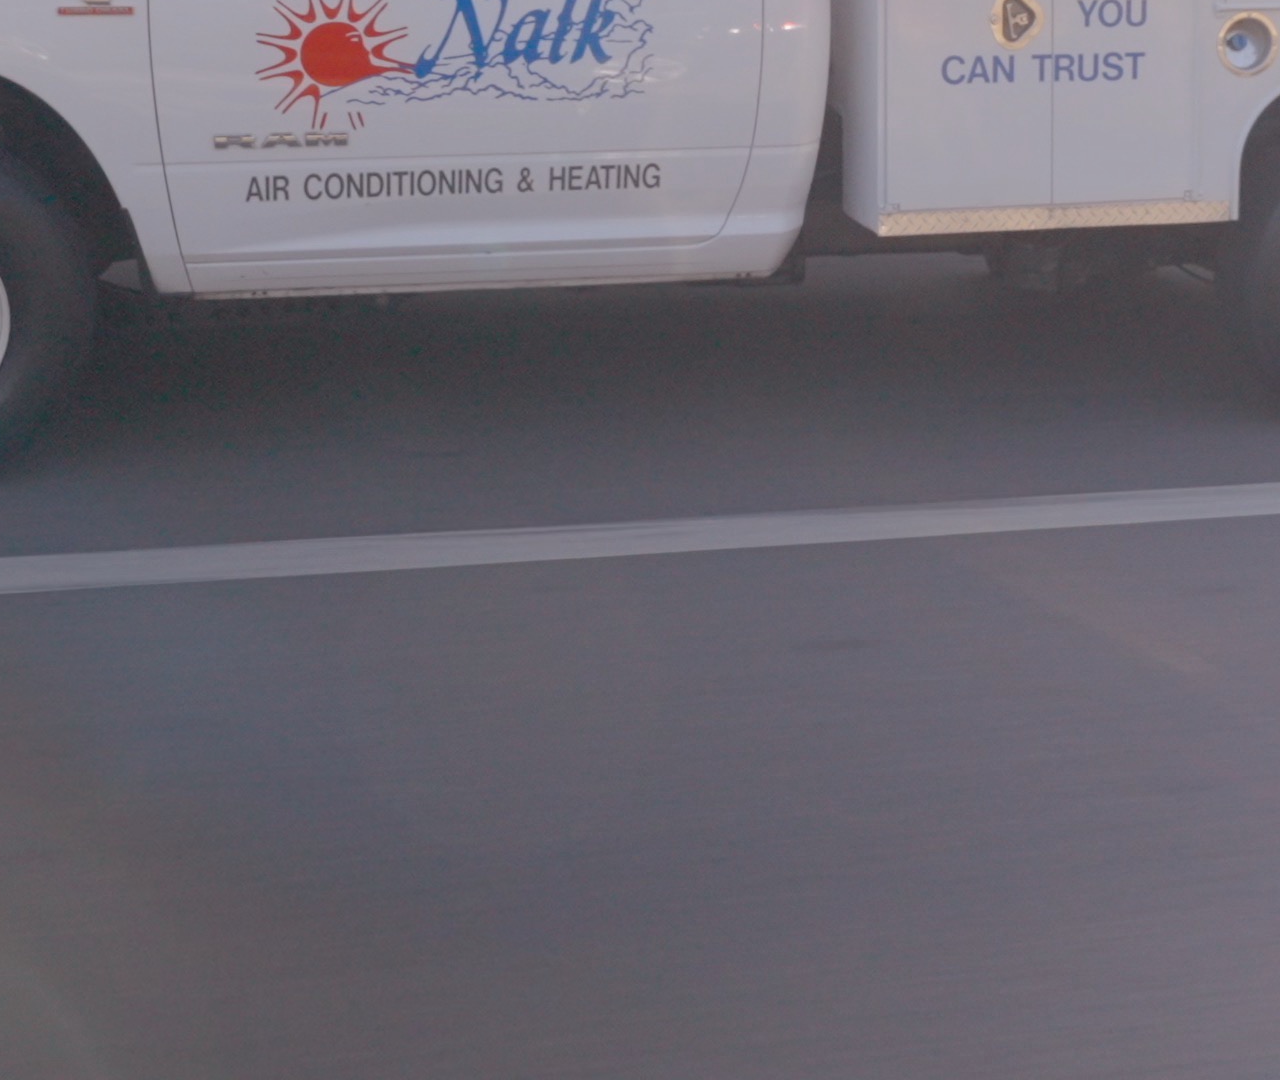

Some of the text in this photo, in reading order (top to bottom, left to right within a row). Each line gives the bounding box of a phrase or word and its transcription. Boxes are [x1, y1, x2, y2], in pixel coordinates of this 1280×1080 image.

[1077, 0, 1147, 27] YOU
[941, 52, 1146, 85] CAN TRUST
[214, 133, 349, 148] RAM
[245, 163, 661, 202] AIR CONDITIONING & HEATING
